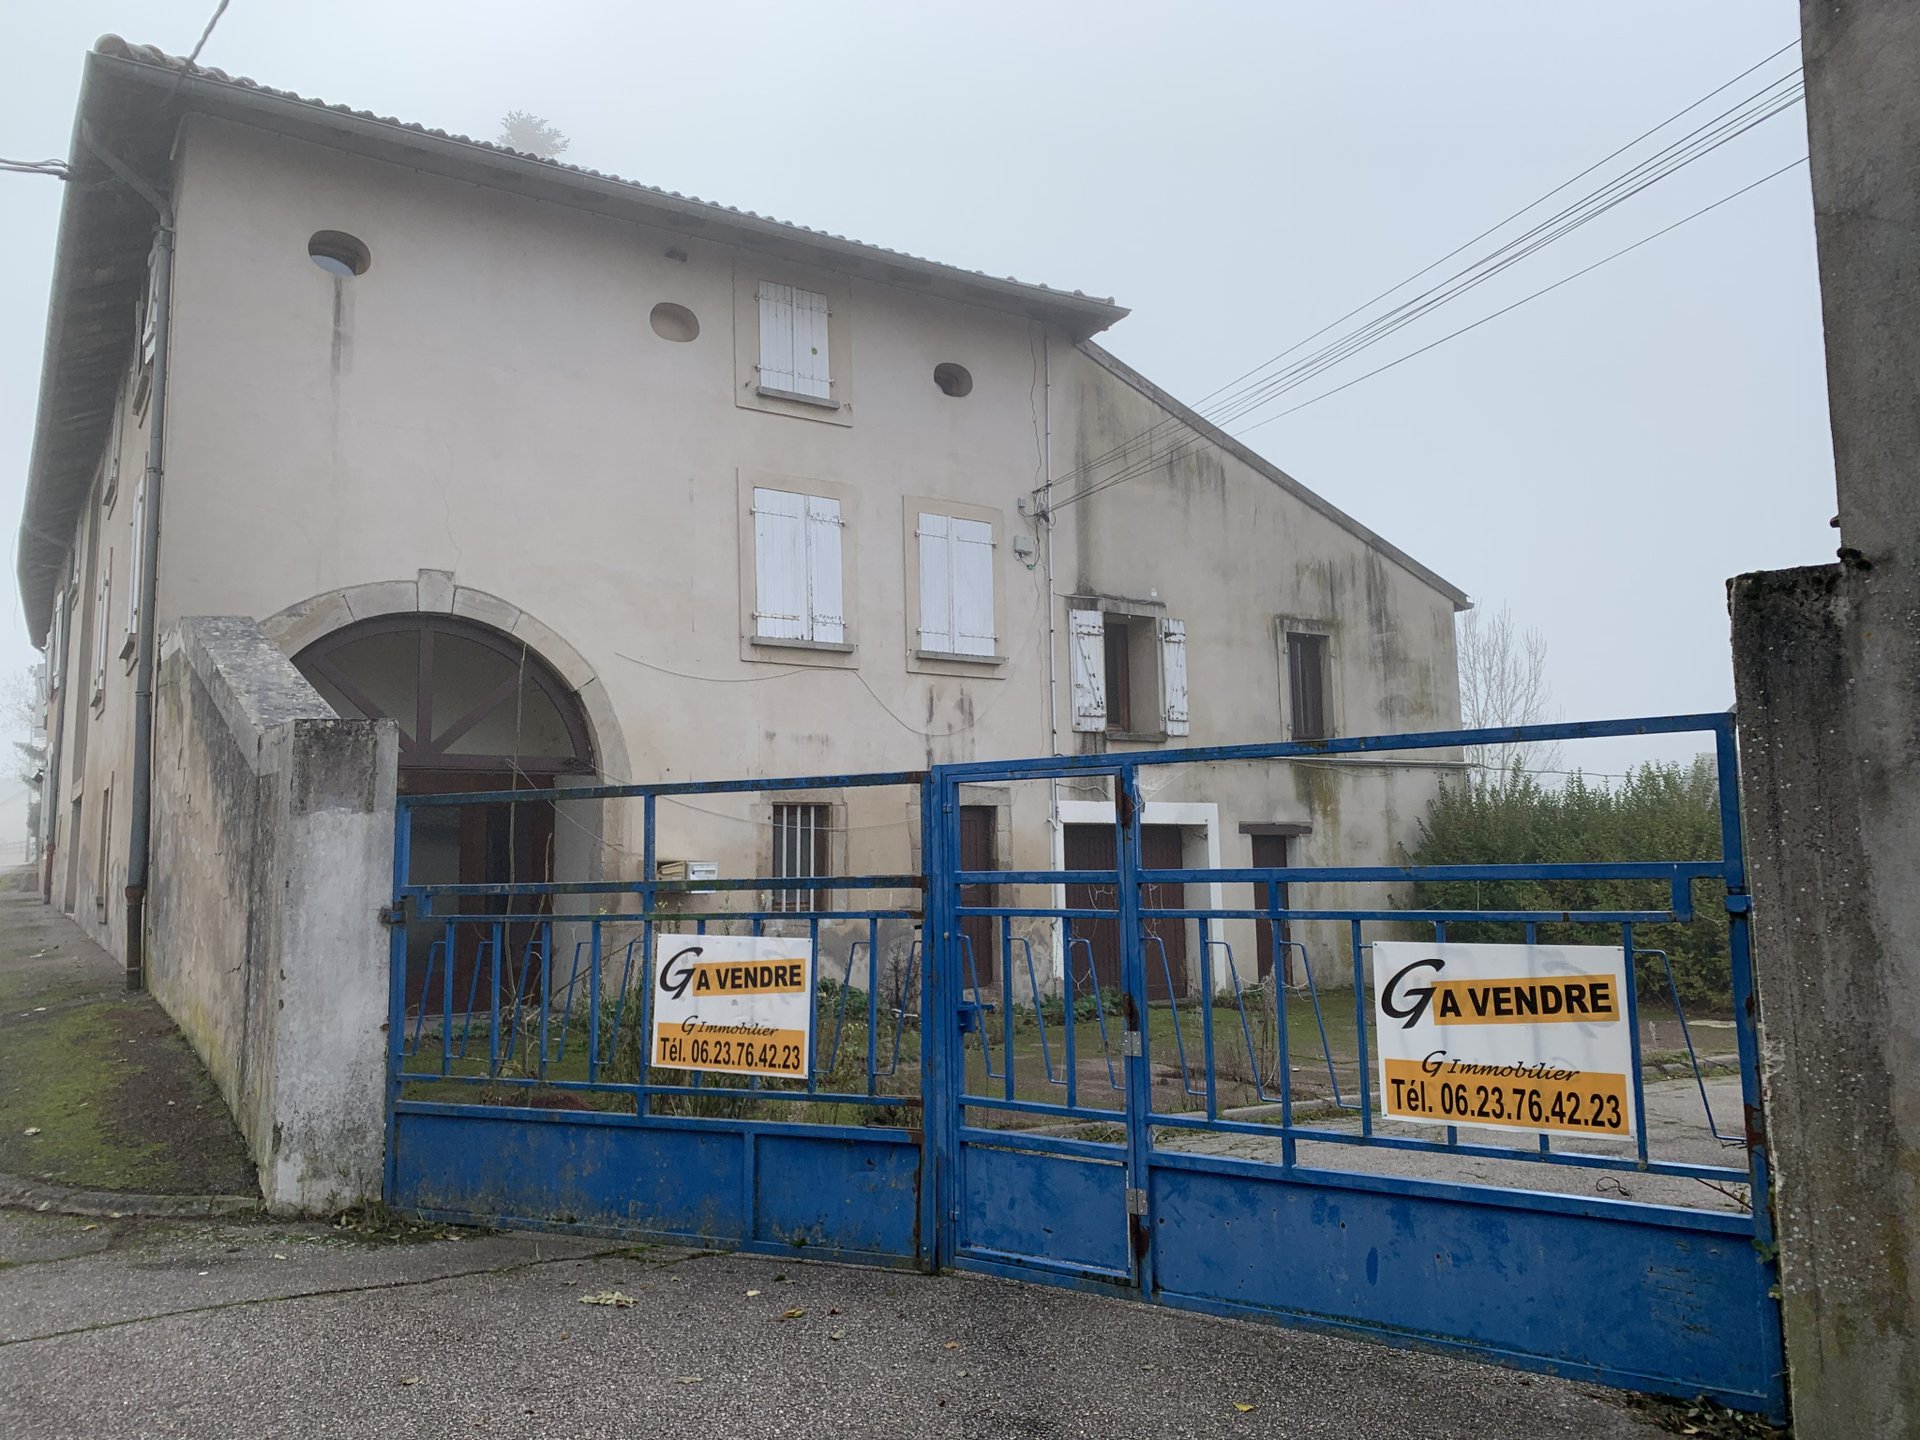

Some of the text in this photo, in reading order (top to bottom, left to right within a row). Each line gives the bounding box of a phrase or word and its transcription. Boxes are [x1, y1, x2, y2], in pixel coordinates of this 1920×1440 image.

[696, 965, 801, 990] A VENDRE
[1440, 983, 1612, 1017] A VENDRE
[661, 1037, 800, 1070] Tél. 06.23.76.42.23
[1391, 1079, 1621, 1128] Tél. 06.23.76.42.23
